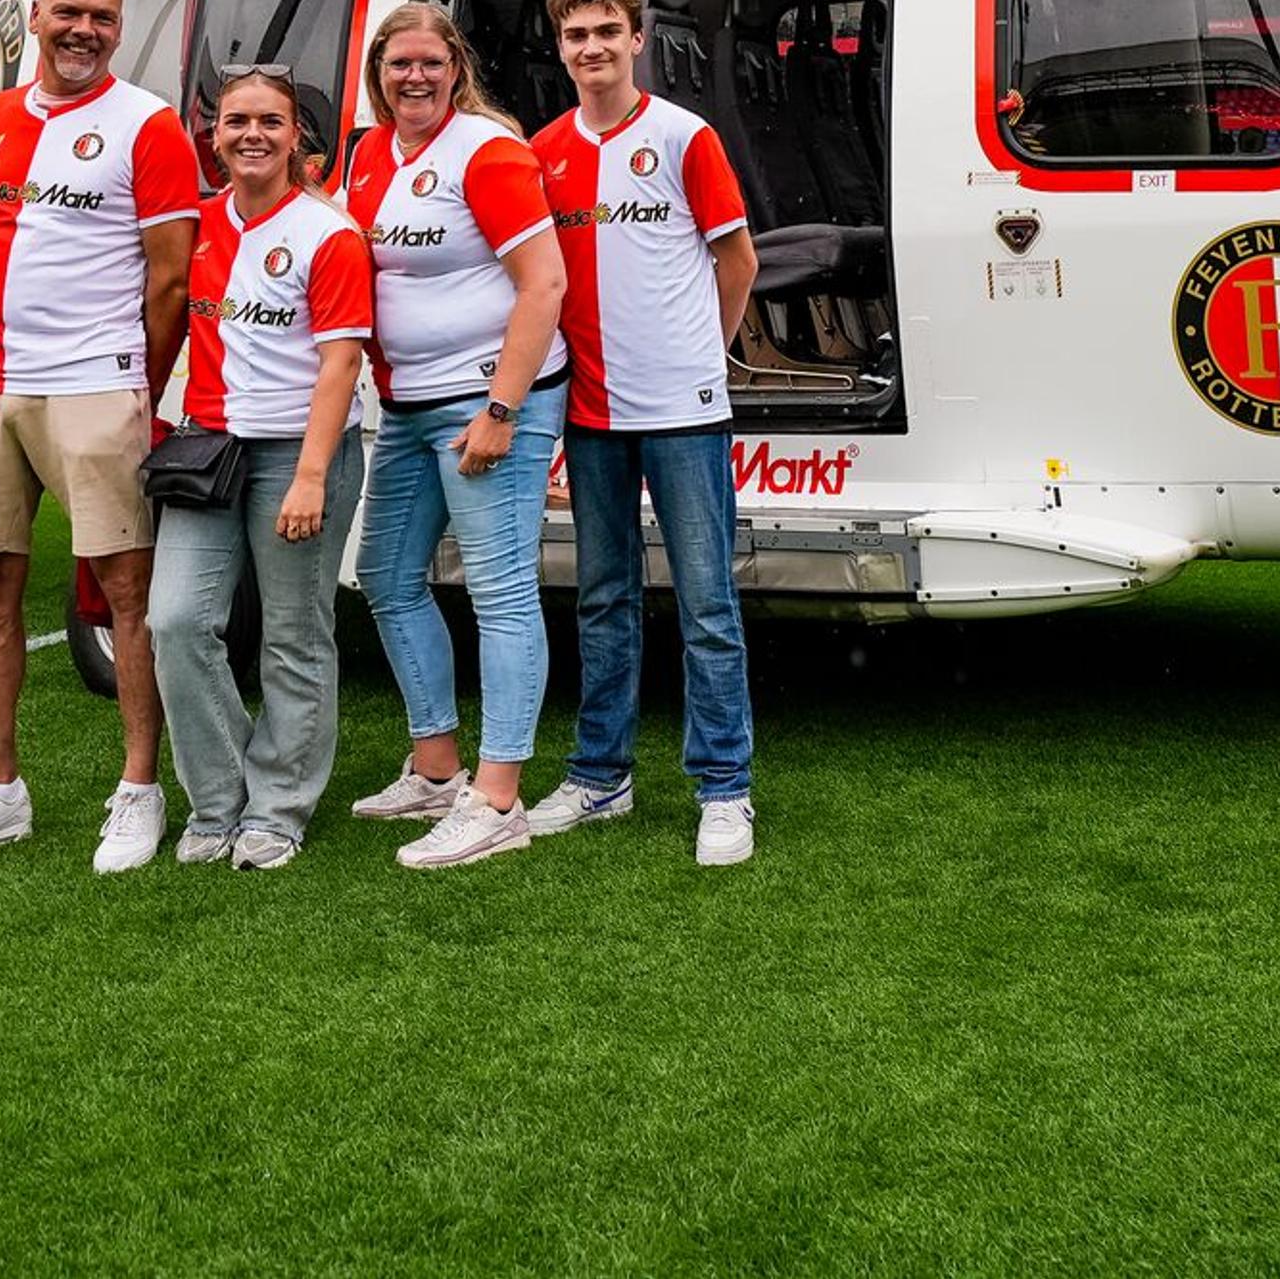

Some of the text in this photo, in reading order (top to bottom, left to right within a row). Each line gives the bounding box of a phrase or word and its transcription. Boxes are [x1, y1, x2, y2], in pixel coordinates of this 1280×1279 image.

[1138, 174, 1168, 188] EXIT
[37, 183, 104, 210] Markt
[609, 200, 671, 224] Markt
[381, 225, 447, 247] Markt
[231, 301, 297, 327] Markt
